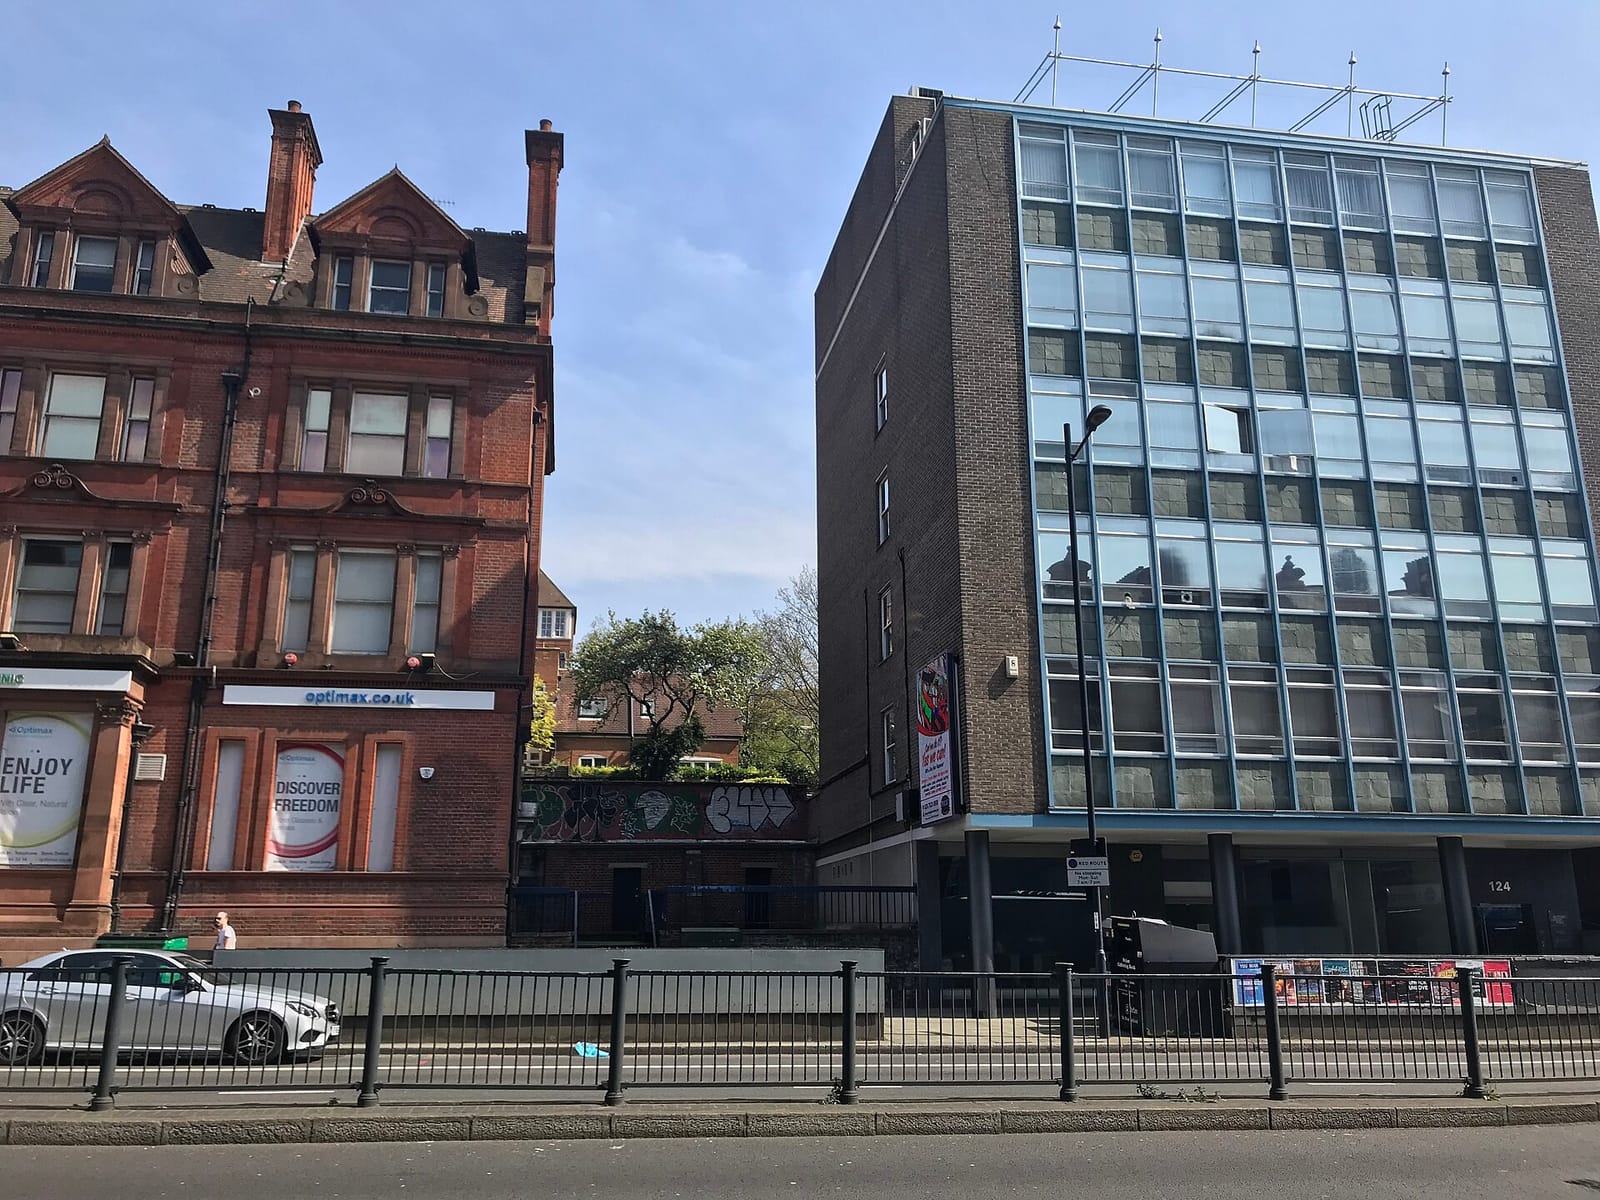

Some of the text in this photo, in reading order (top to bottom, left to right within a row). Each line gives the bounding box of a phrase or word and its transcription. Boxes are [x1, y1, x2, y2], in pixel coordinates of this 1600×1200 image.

[0, 673, 24, 685] NIC
[305, 690, 414, 705] optimax.co.uk
[17, 726, 53, 735] Optimax
[2, 757, 73, 776] ENJOY
[0, 776, 46, 794] LIFE
[276, 781, 341, 795] DISCOVER
[275, 799, 339, 812] FREEDOM
[1489, 881, 1511, 892] 124
